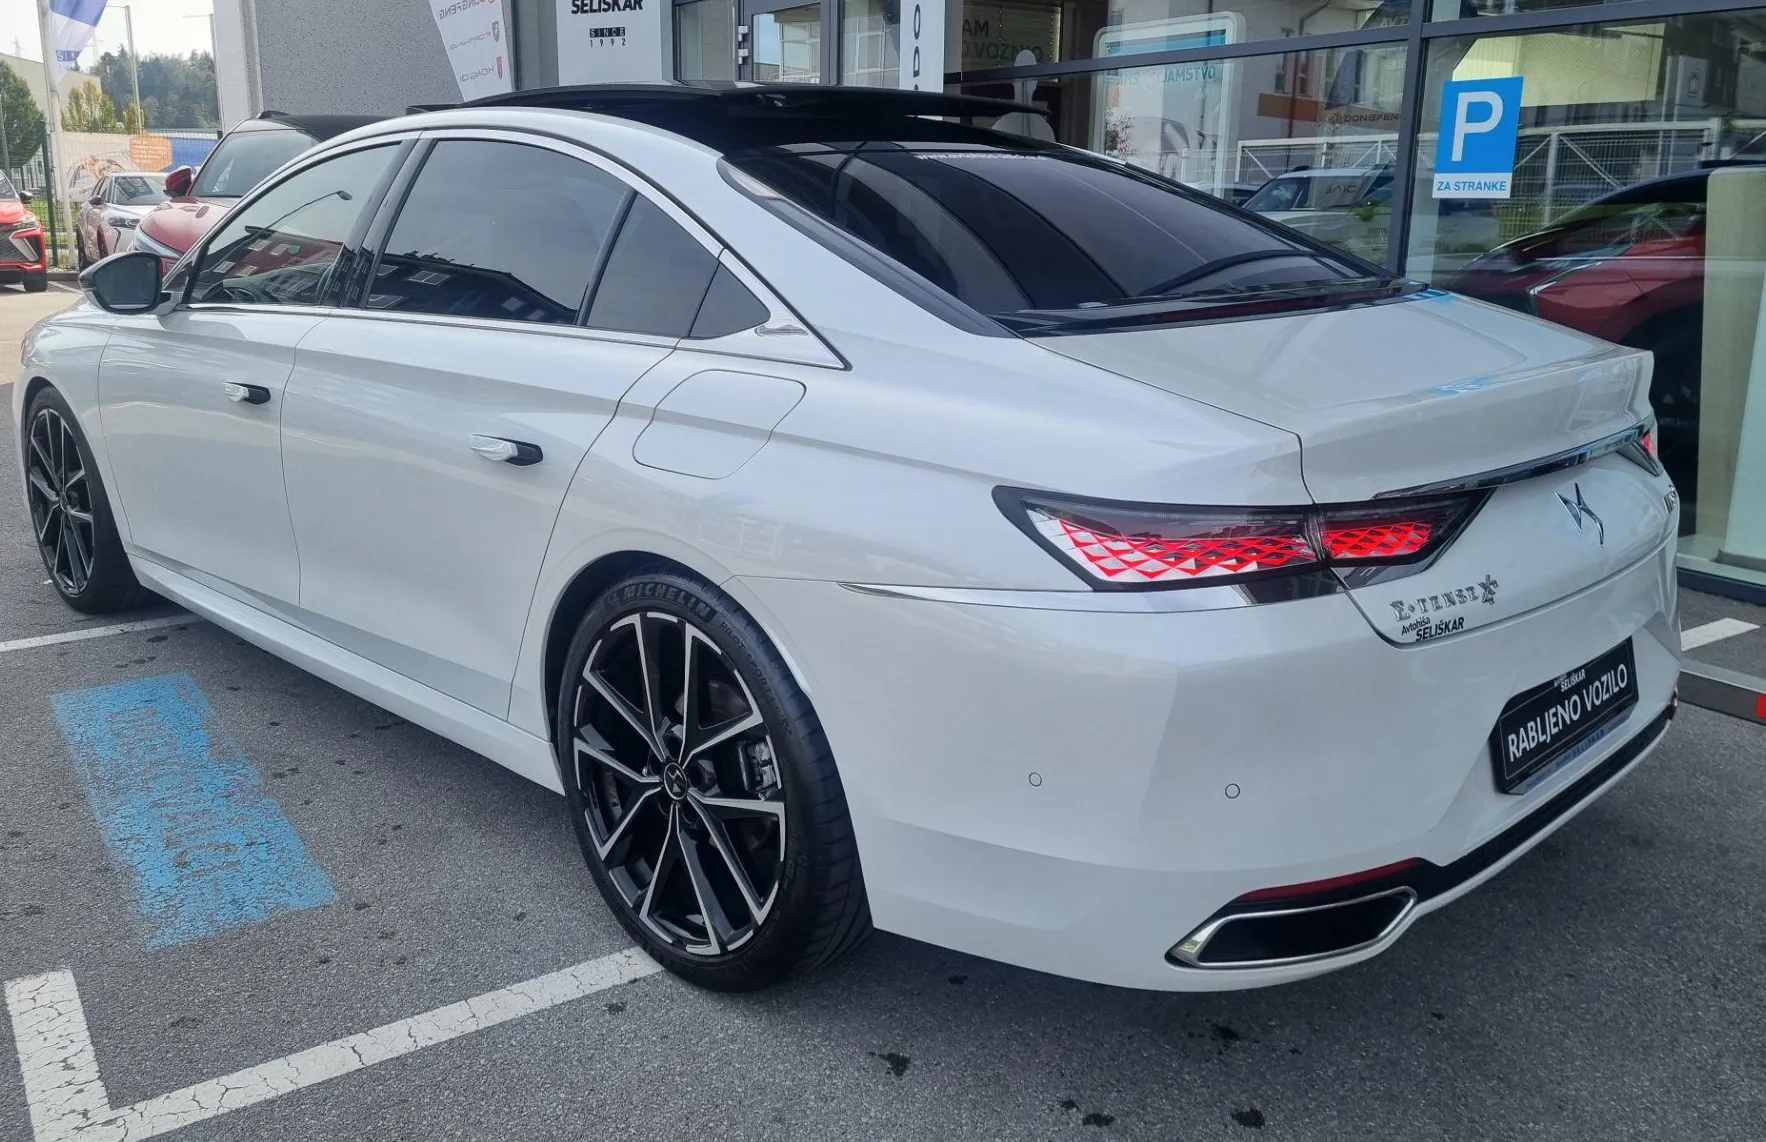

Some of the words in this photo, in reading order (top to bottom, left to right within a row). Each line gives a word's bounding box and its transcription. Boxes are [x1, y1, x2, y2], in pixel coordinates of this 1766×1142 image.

[590, 27, 625, 38] SINCE
[590, 38, 626, 48] 1992
[1344, 112, 1399, 123] DONGFEN
[1451, 90, 1504, 162] P
[1437, 181, 1451, 192] ZA
[1453, 180, 1507, 192] STRANKE
[622, 582, 713, 619] MICHELIN
[719, 622, 746, 650] PILOT
[1507, 694, 1581, 763] RABLJENO
[1582, 663, 1628, 712] VOZILO
